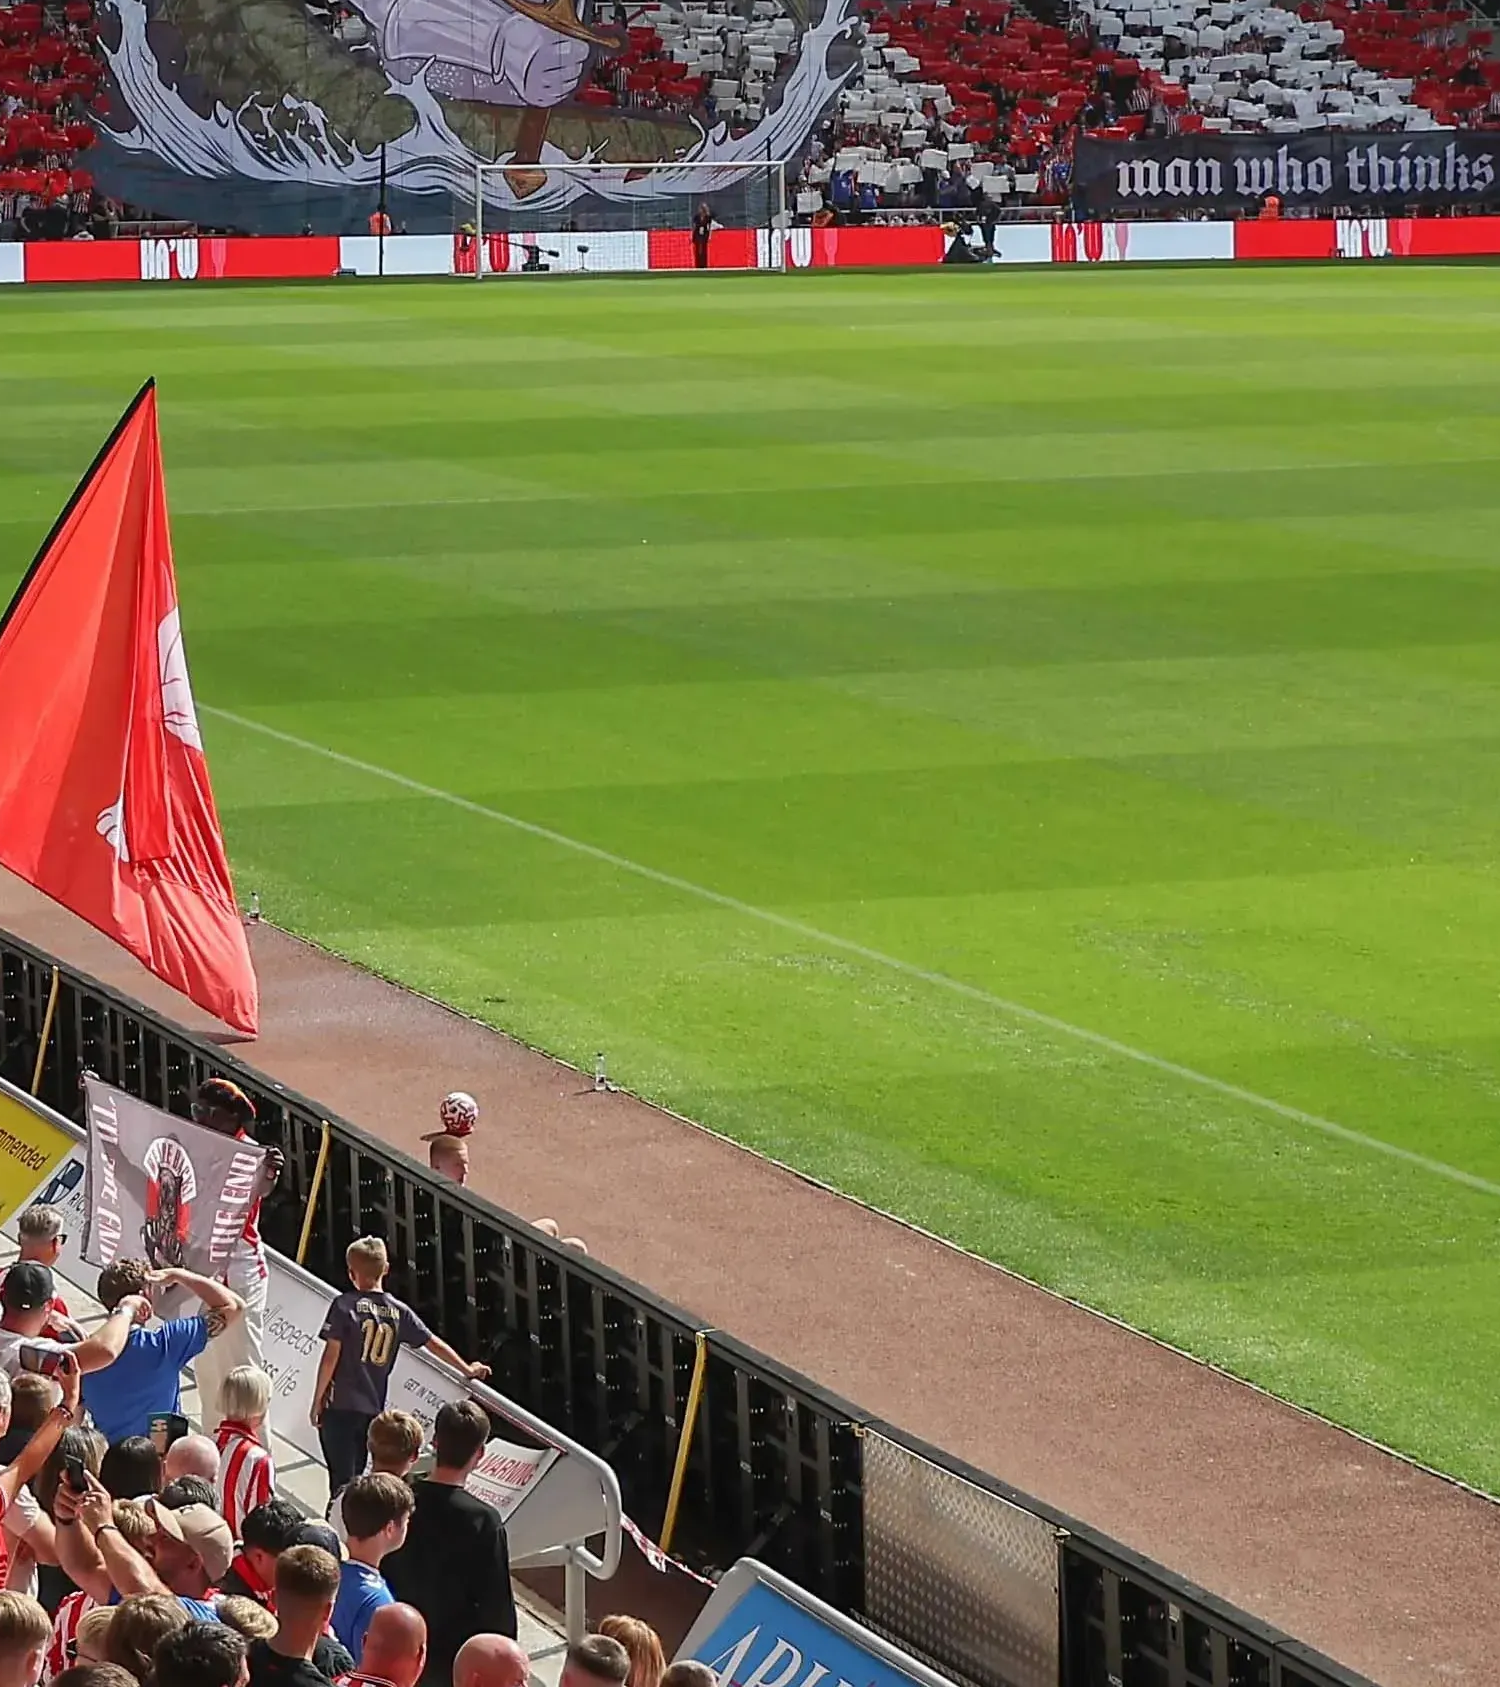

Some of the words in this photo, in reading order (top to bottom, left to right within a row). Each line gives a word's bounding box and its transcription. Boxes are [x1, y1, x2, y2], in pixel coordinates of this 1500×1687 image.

[1117, 157, 1223, 198] man
[1233, 144, 1332, 196] who
[1346, 141, 1495, 193] thinks
[219, 1151, 261, 1205] END
[208, 1208, 250, 1264] THE
[268, 1315, 320, 1356] aspects
[360, 1318, 396, 1368] 10
[275, 1365, 301, 1398] life
[426, 1390, 447, 1410] TOUC
